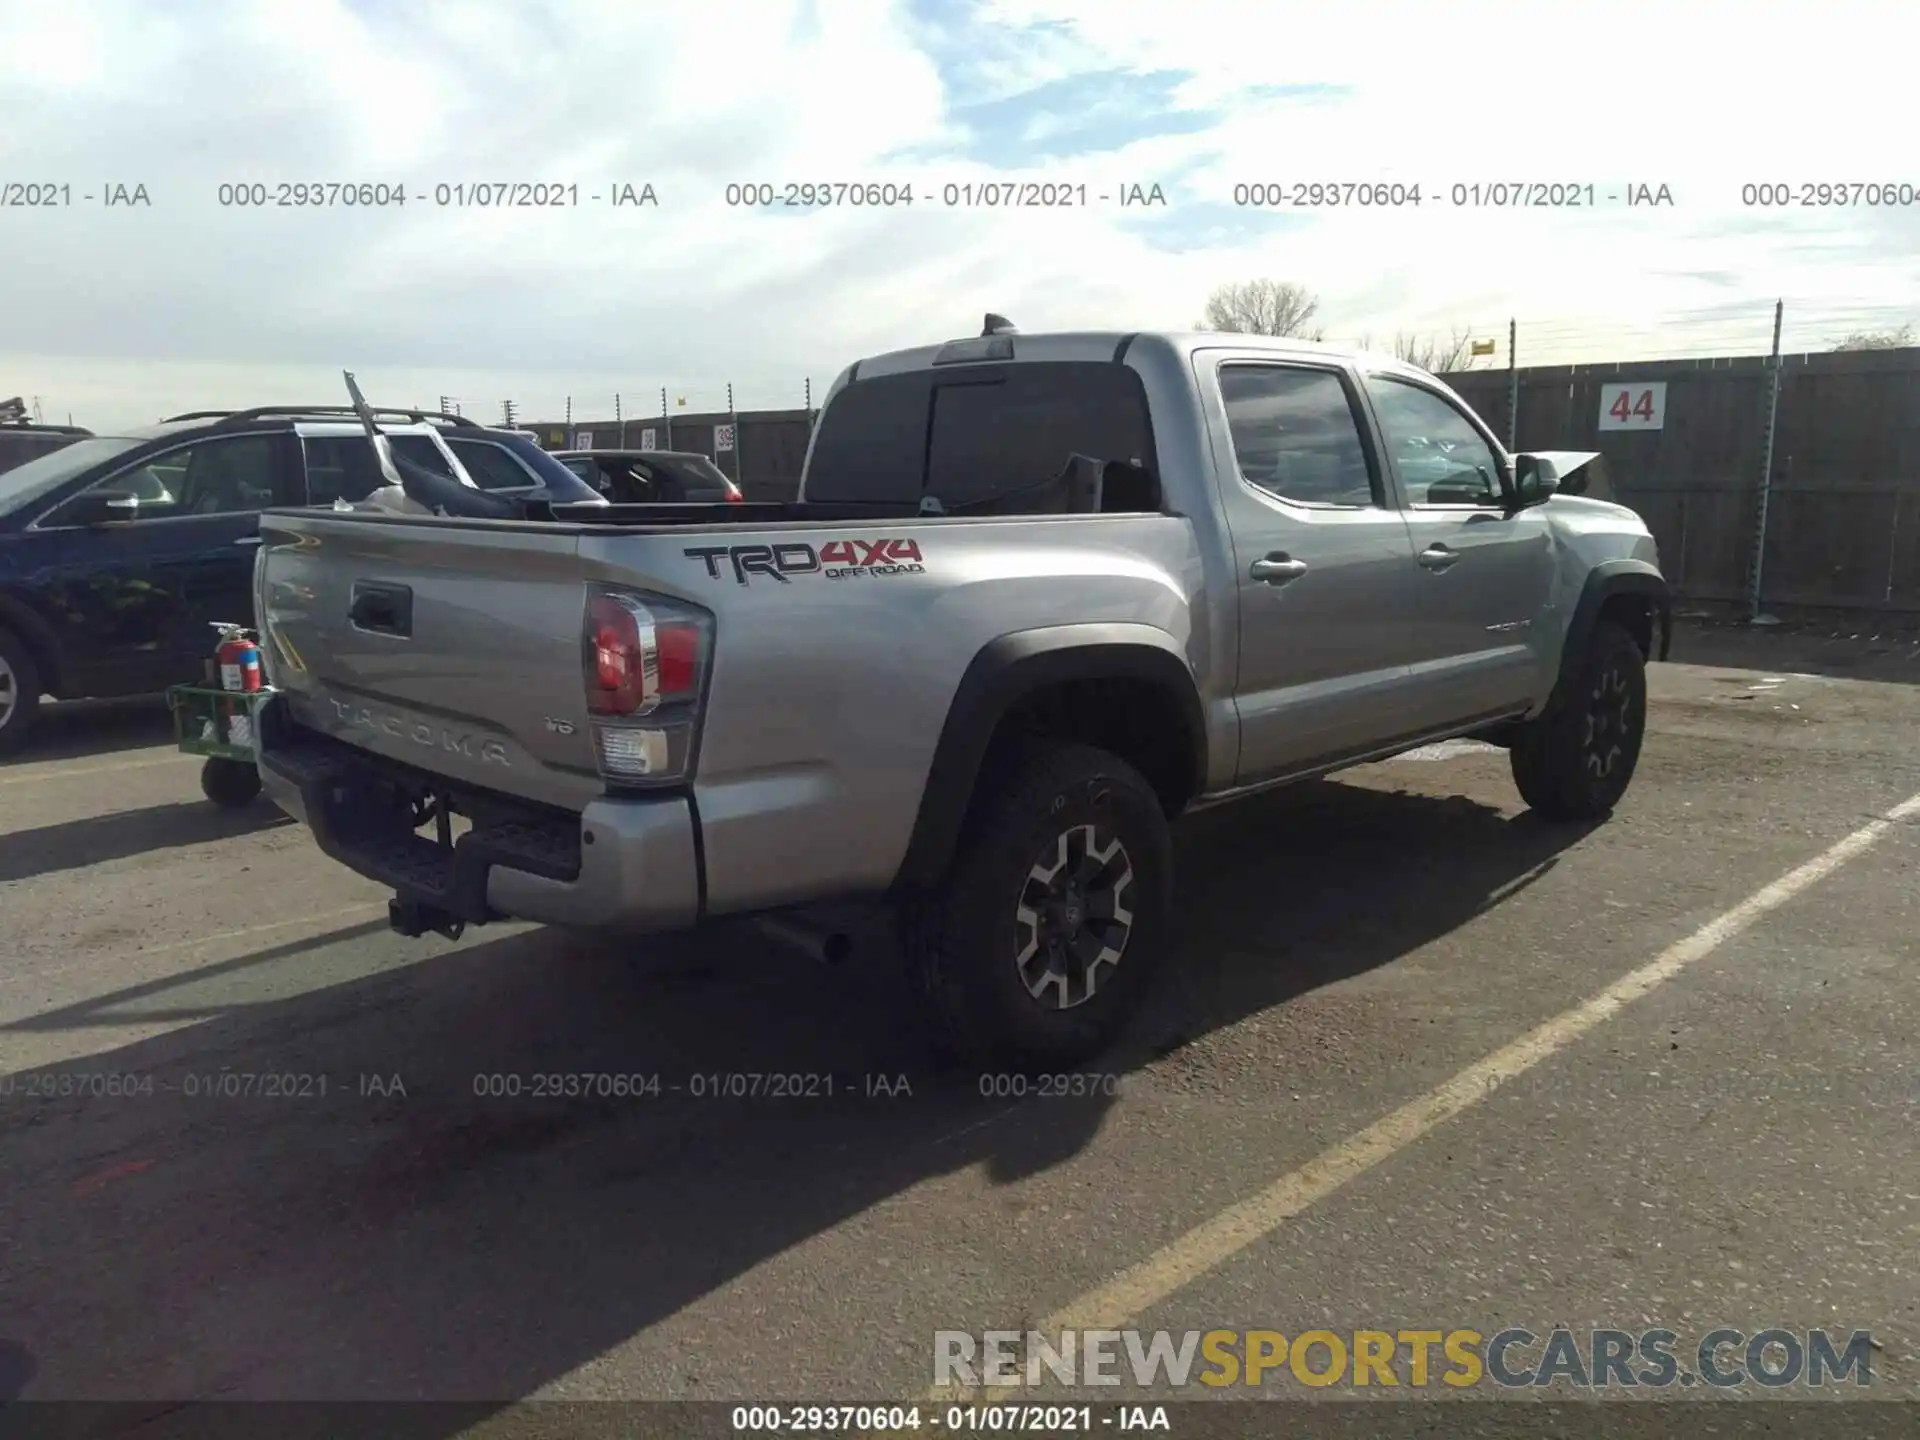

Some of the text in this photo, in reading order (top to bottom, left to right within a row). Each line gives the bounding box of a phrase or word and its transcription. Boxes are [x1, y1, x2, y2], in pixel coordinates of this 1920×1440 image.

[1609, 389, 1655, 423] 44
[683, 543, 821, 587] TRD
[825, 563, 926, 583] OFF ROAD
[329, 697, 512, 767] TACOMA
[543, 716, 577, 735] V6
